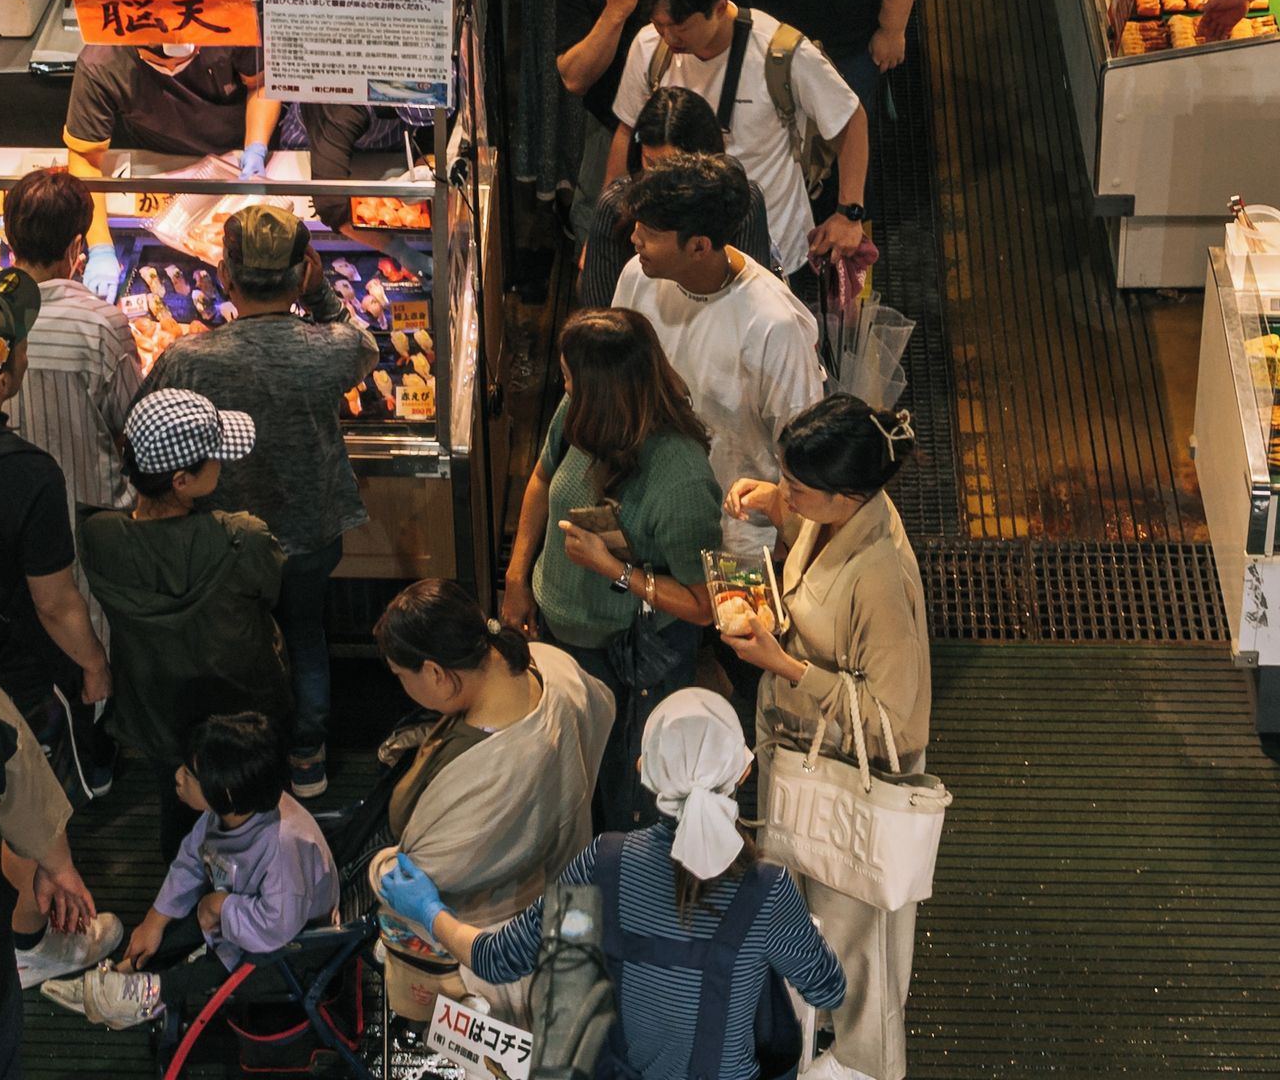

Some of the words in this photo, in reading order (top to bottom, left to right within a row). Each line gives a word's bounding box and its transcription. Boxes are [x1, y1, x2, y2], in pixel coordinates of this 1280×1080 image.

[401, 391, 430, 402] 赤えび
[768, 778, 884, 873] DIESEL
[437, 1003, 532, 1064] 入口はコチラ
